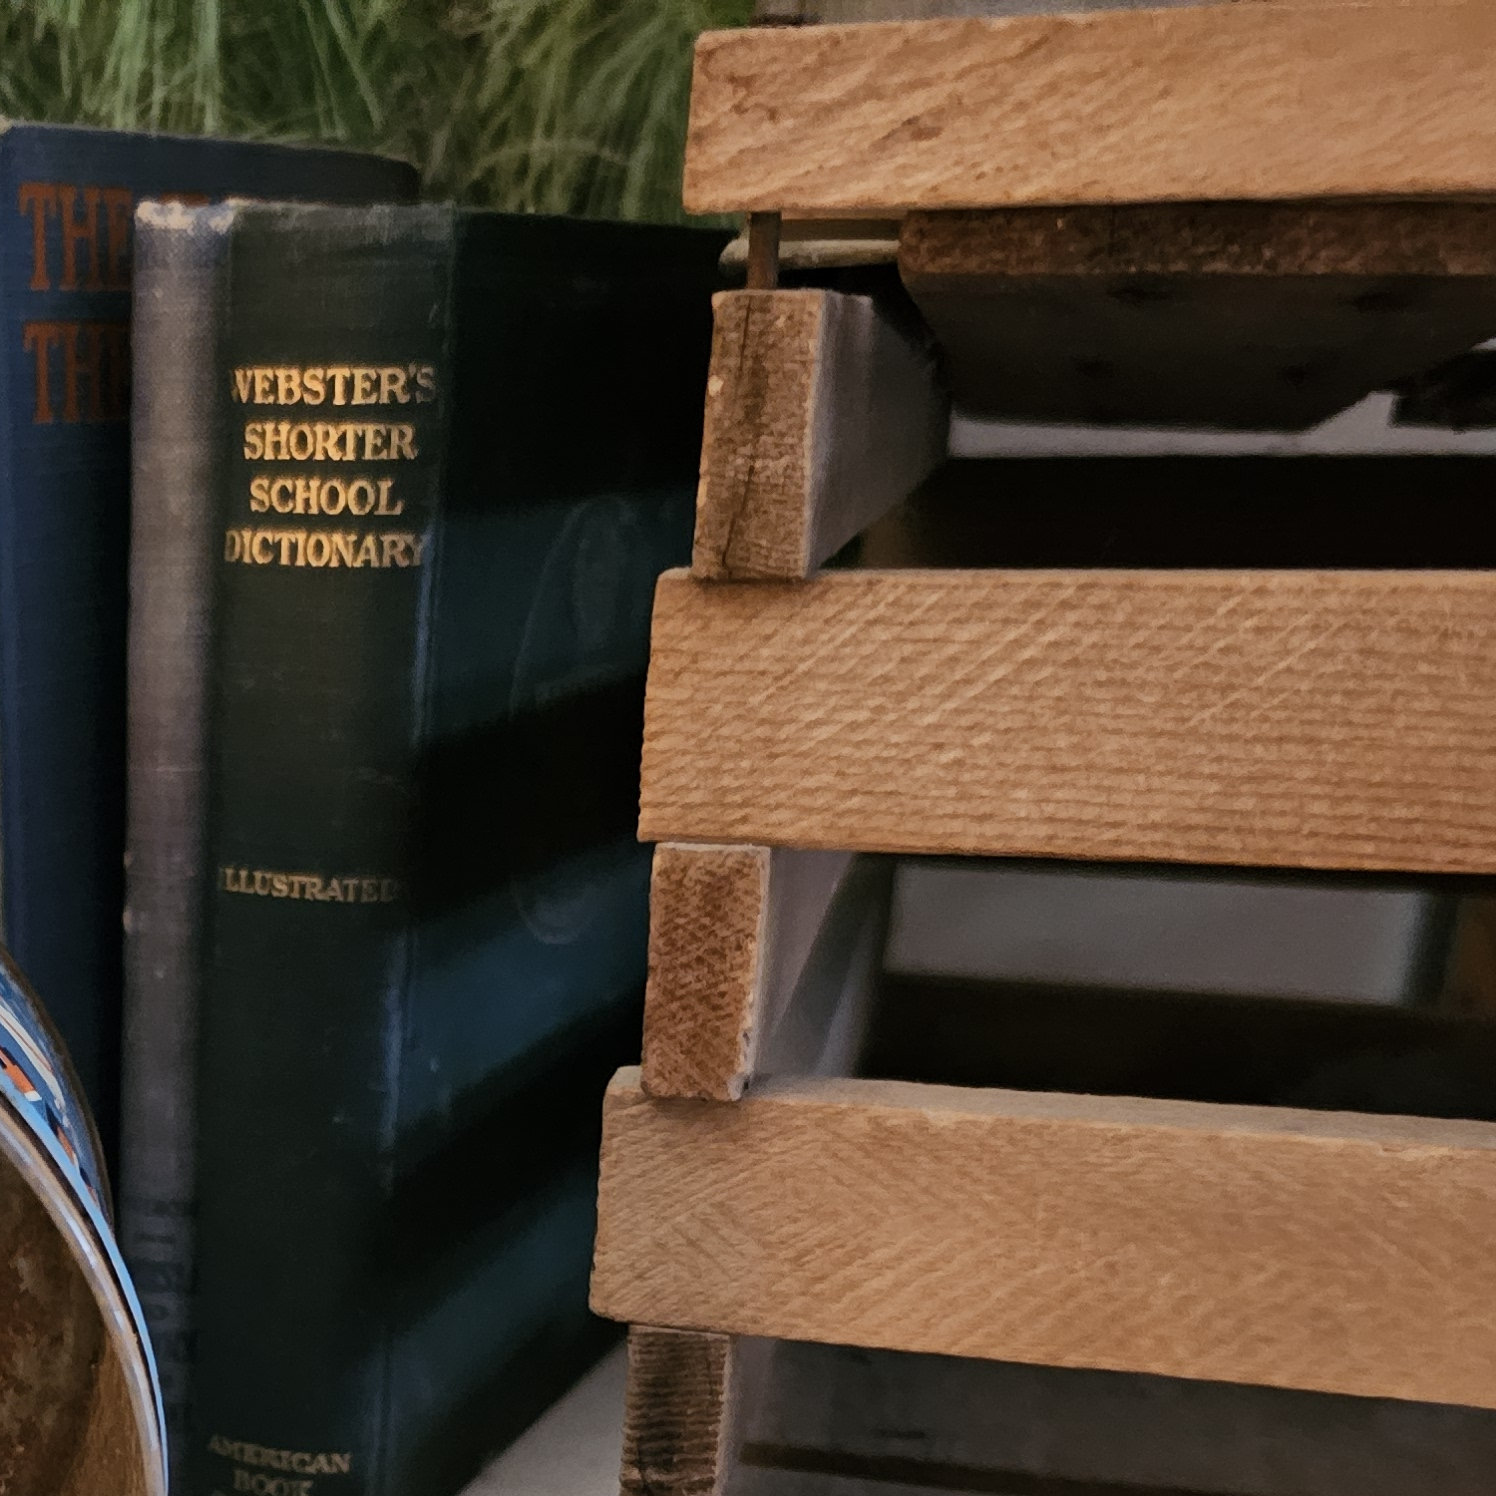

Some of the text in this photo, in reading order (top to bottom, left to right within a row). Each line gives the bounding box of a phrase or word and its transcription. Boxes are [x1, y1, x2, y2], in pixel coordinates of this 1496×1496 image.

[231, 363, 437, 405] WEBSTER'S
[244, 421, 419, 461] SHORTER
[250, 476, 403, 515] SCHOOL
[224, 529, 427, 568] DICTIONARY
[219, 866, 400, 903] LLUSTRATED
